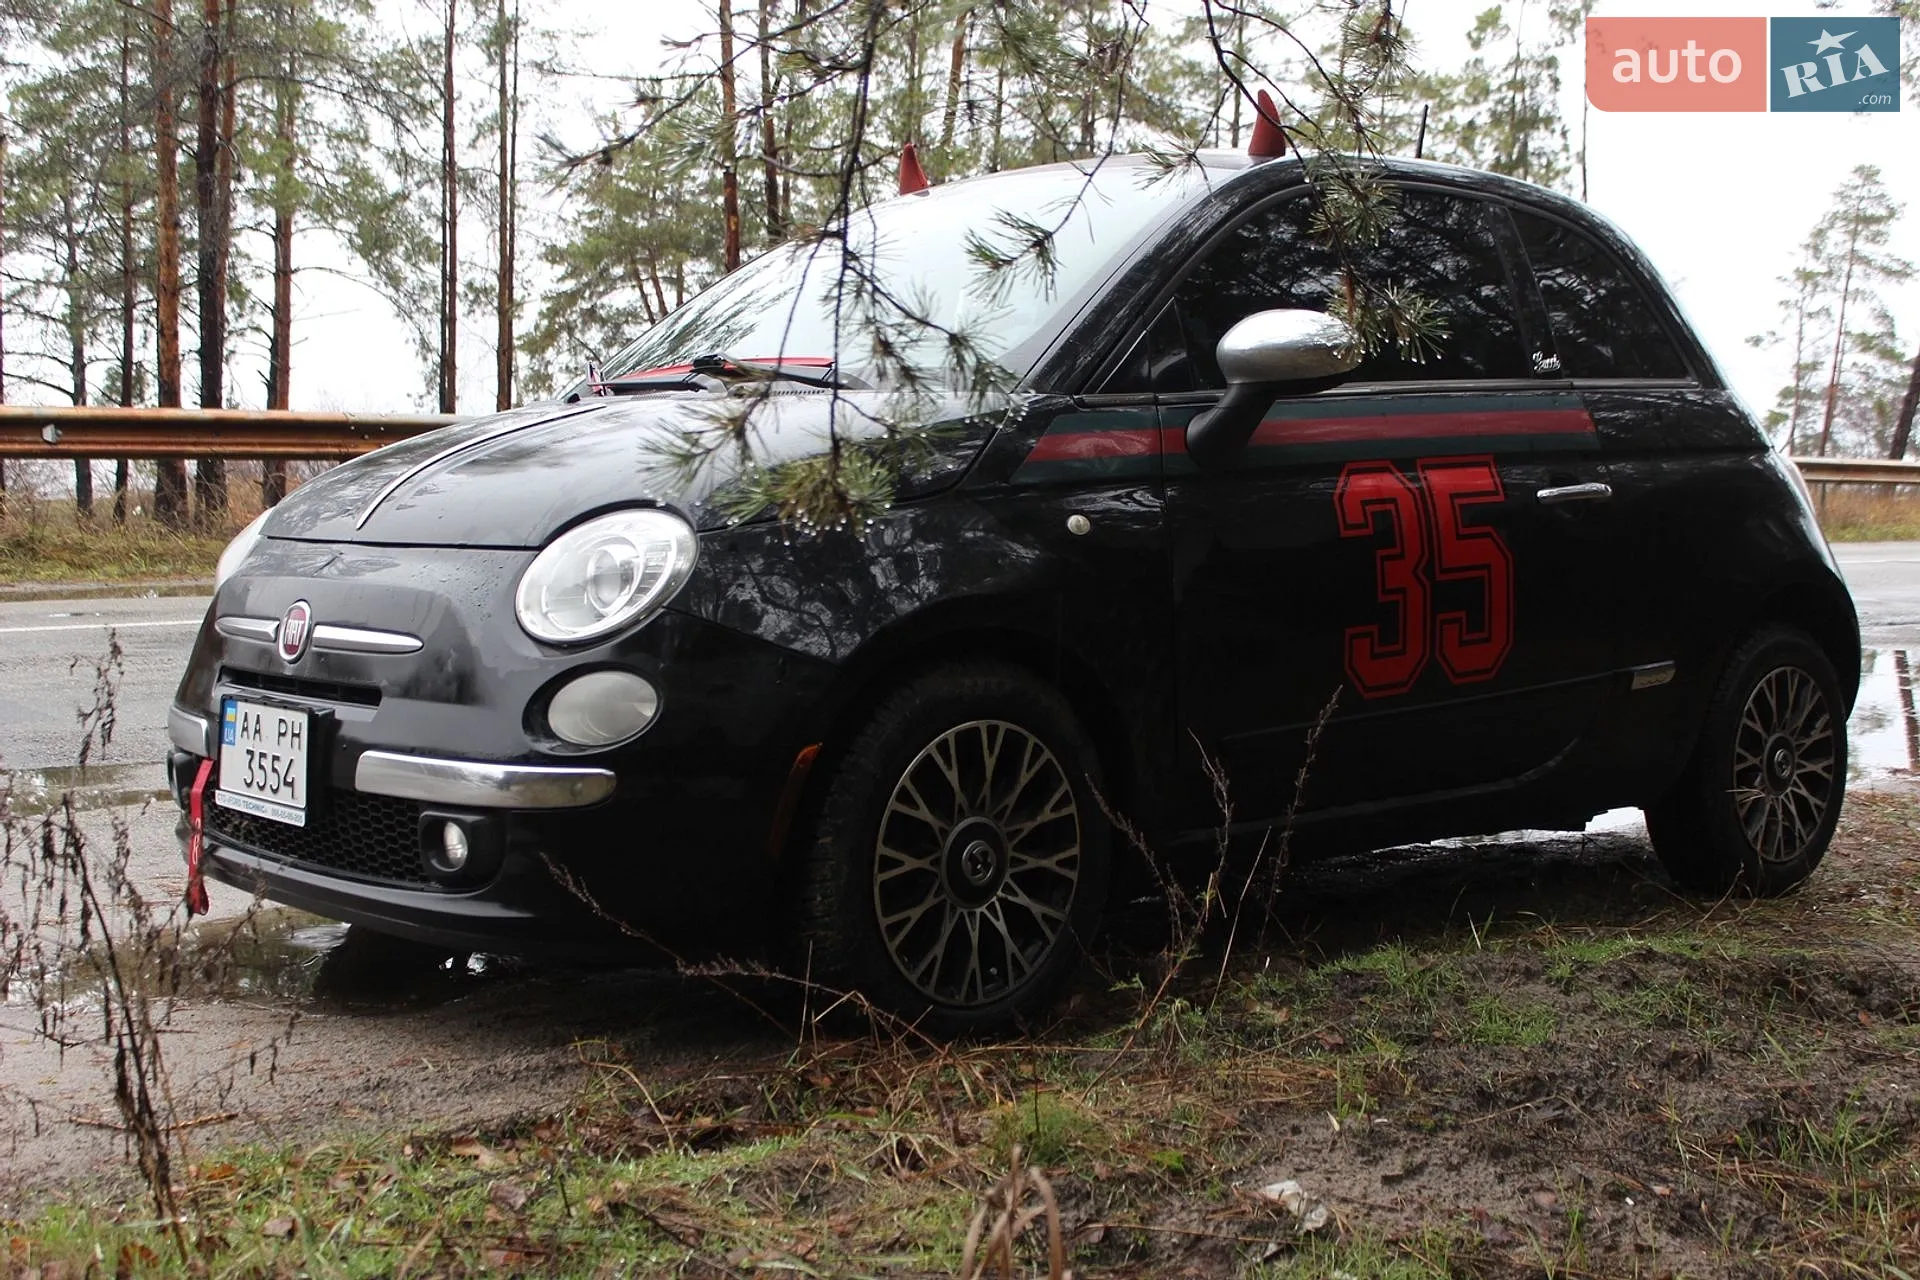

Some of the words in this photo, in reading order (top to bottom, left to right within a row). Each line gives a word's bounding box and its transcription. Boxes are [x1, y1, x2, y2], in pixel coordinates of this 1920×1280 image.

[1334, 454, 1514, 699] 35
[285, 618, 305, 646] FIAT
[240, 711, 262, 742] AA
[277, 718, 302, 750] PH
[243, 748, 296, 800] 3554
